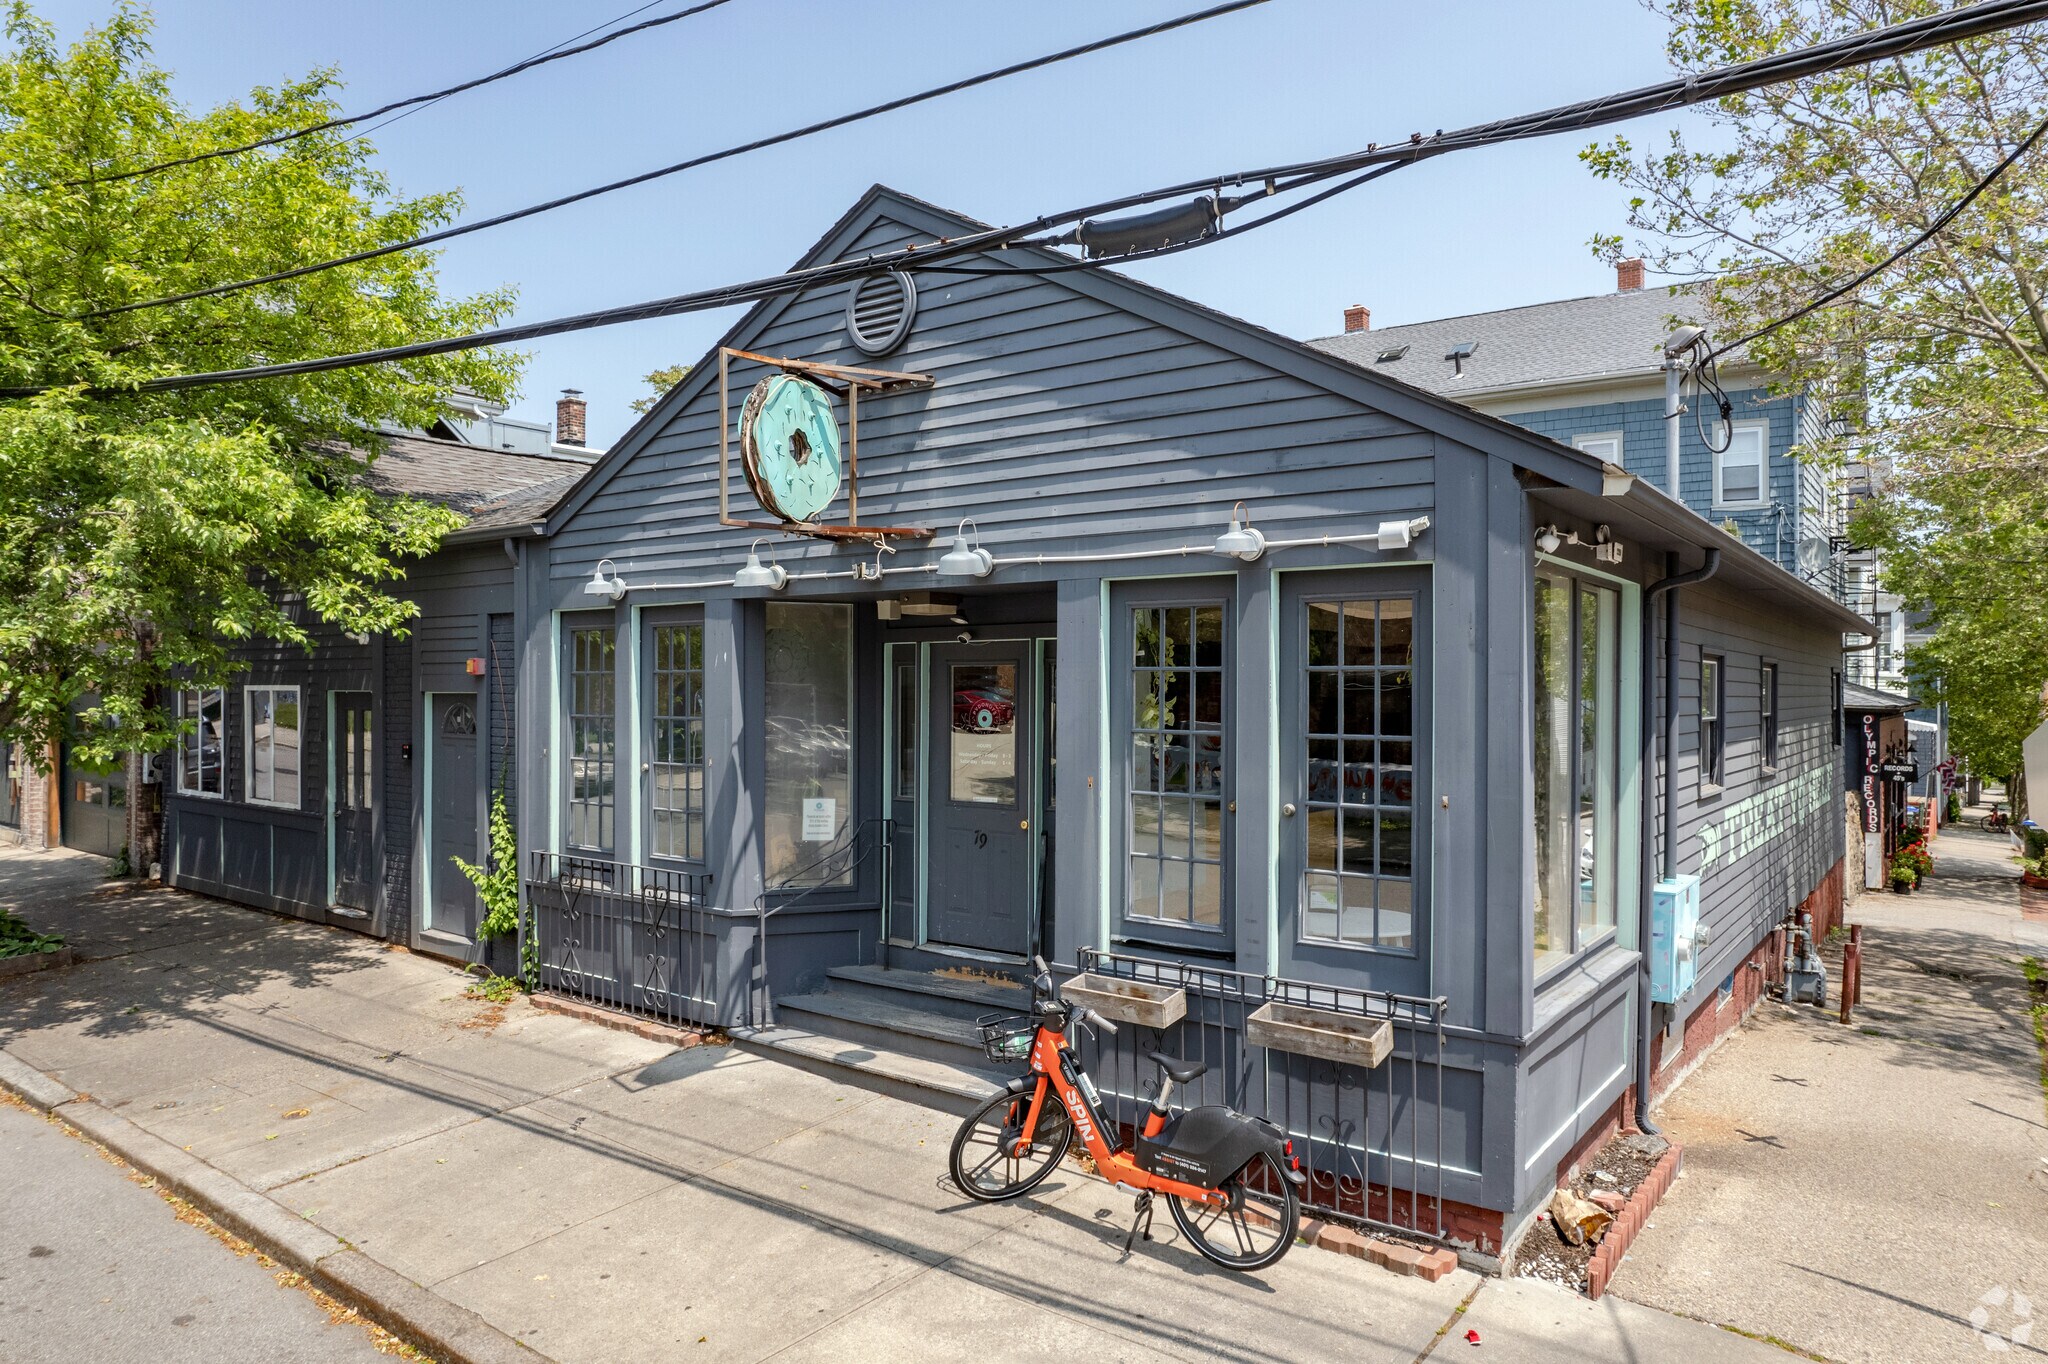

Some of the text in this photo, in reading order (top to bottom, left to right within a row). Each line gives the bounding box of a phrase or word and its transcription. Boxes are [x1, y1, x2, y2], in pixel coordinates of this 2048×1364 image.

[1863, 715, 1879, 832] OLYMPIC RECORDS
[1884, 764, 1913, 772] RECORDS
[1724, 784, 1786, 865] TREAT
[1066, 1090, 1095, 1142] SPIN
